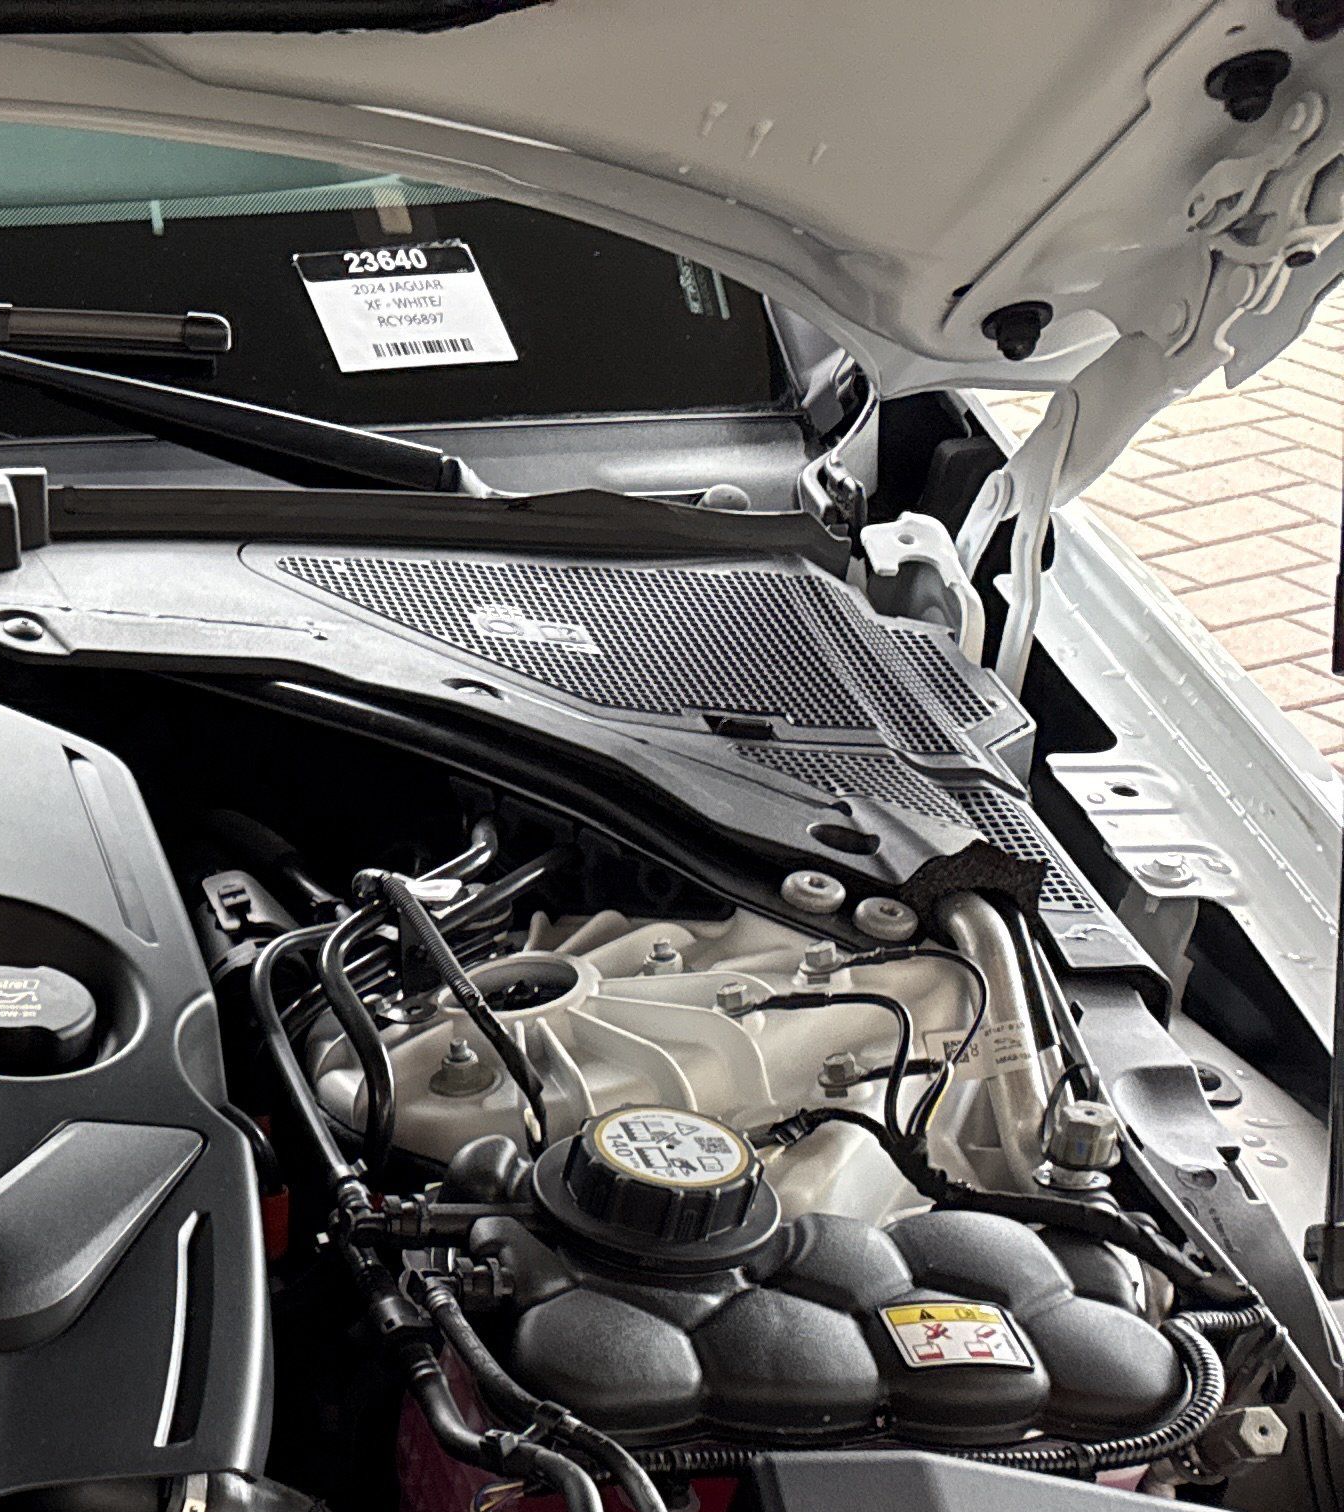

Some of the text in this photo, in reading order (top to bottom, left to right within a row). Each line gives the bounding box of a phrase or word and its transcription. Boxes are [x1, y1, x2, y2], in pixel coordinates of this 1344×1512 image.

[343, 248, 427, 273] 23640
[352, 279, 443, 295] 2024 JAGUAR
[365, 299, 381, 310] XF
[606, 1134, 633, 1157] 140
